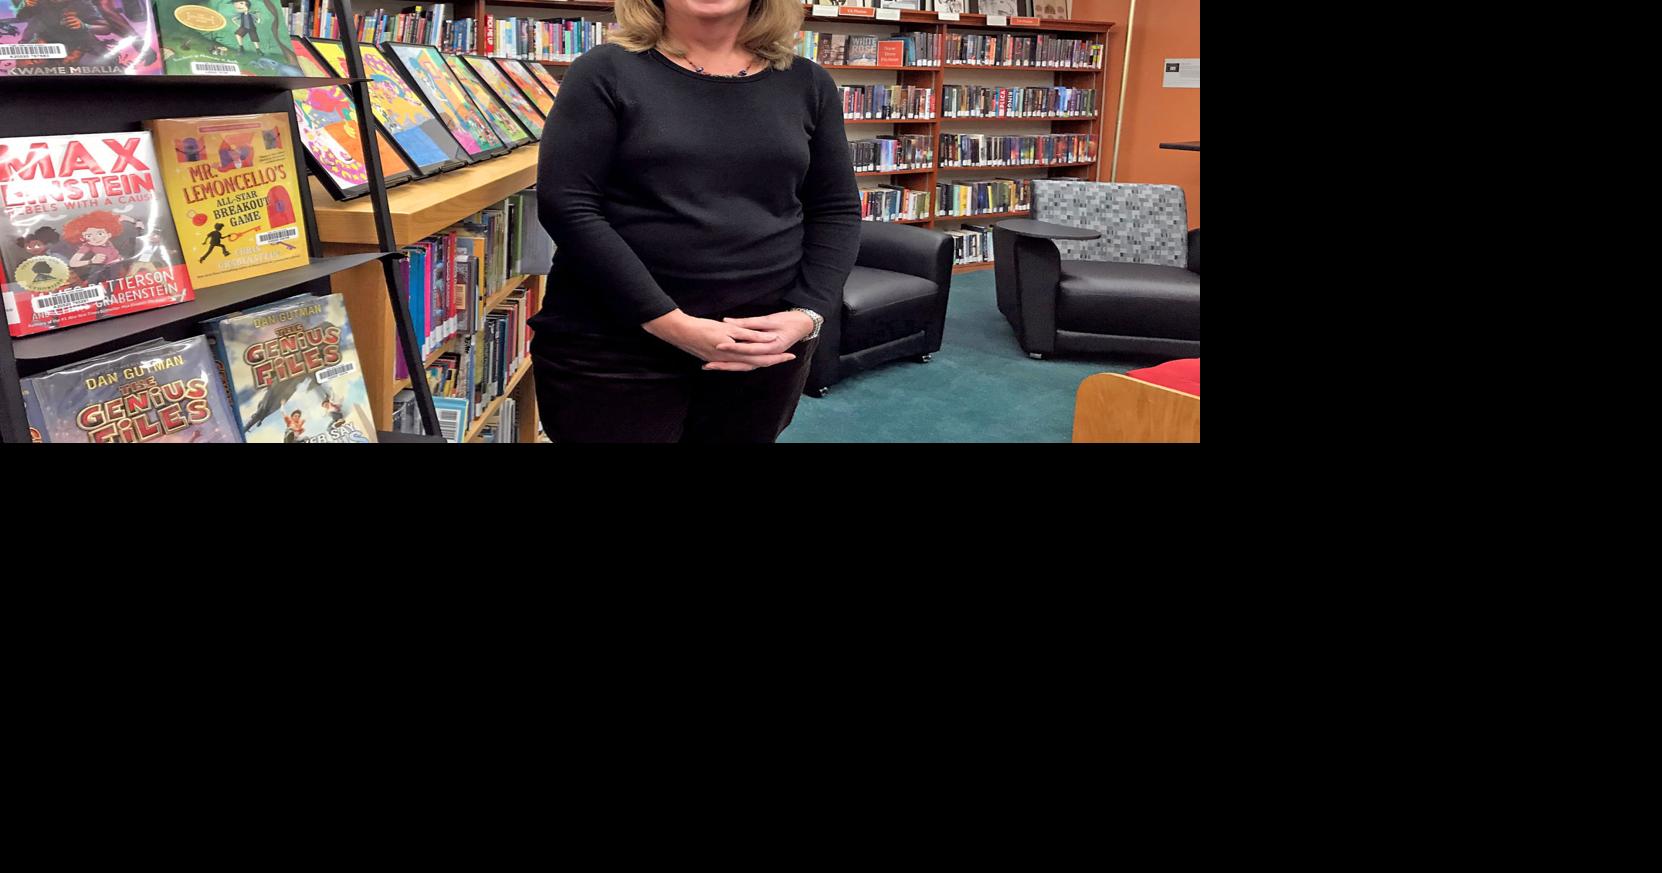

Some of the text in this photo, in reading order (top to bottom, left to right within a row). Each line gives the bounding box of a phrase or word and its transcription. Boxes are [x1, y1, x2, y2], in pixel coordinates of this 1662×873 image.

[852, 36, 877, 46] WHITE
[852, 45, 877, 54] ROSE
[8, 65, 122, 75] KWAME MBALIA
[0, 137, 150, 182] MAX
[189, 163, 218, 183] MR.
[183, 164, 287, 205] LEMONCELLO'S
[64, 198, 98, 210] WITH
[217, 191, 258, 207] ALL-STAR
[213, 197, 269, 220] BREAKOUT
[230, 211, 261, 227] GAME
[95, 283, 179, 308] GRABENSTEIN
[254, 305, 322, 328] DAN GUTMAN
[275, 323, 304, 336] THE
[85, 371, 119, 390] DAN
[119, 376, 158, 395] THE
[330, 422, 355, 439] SAY
